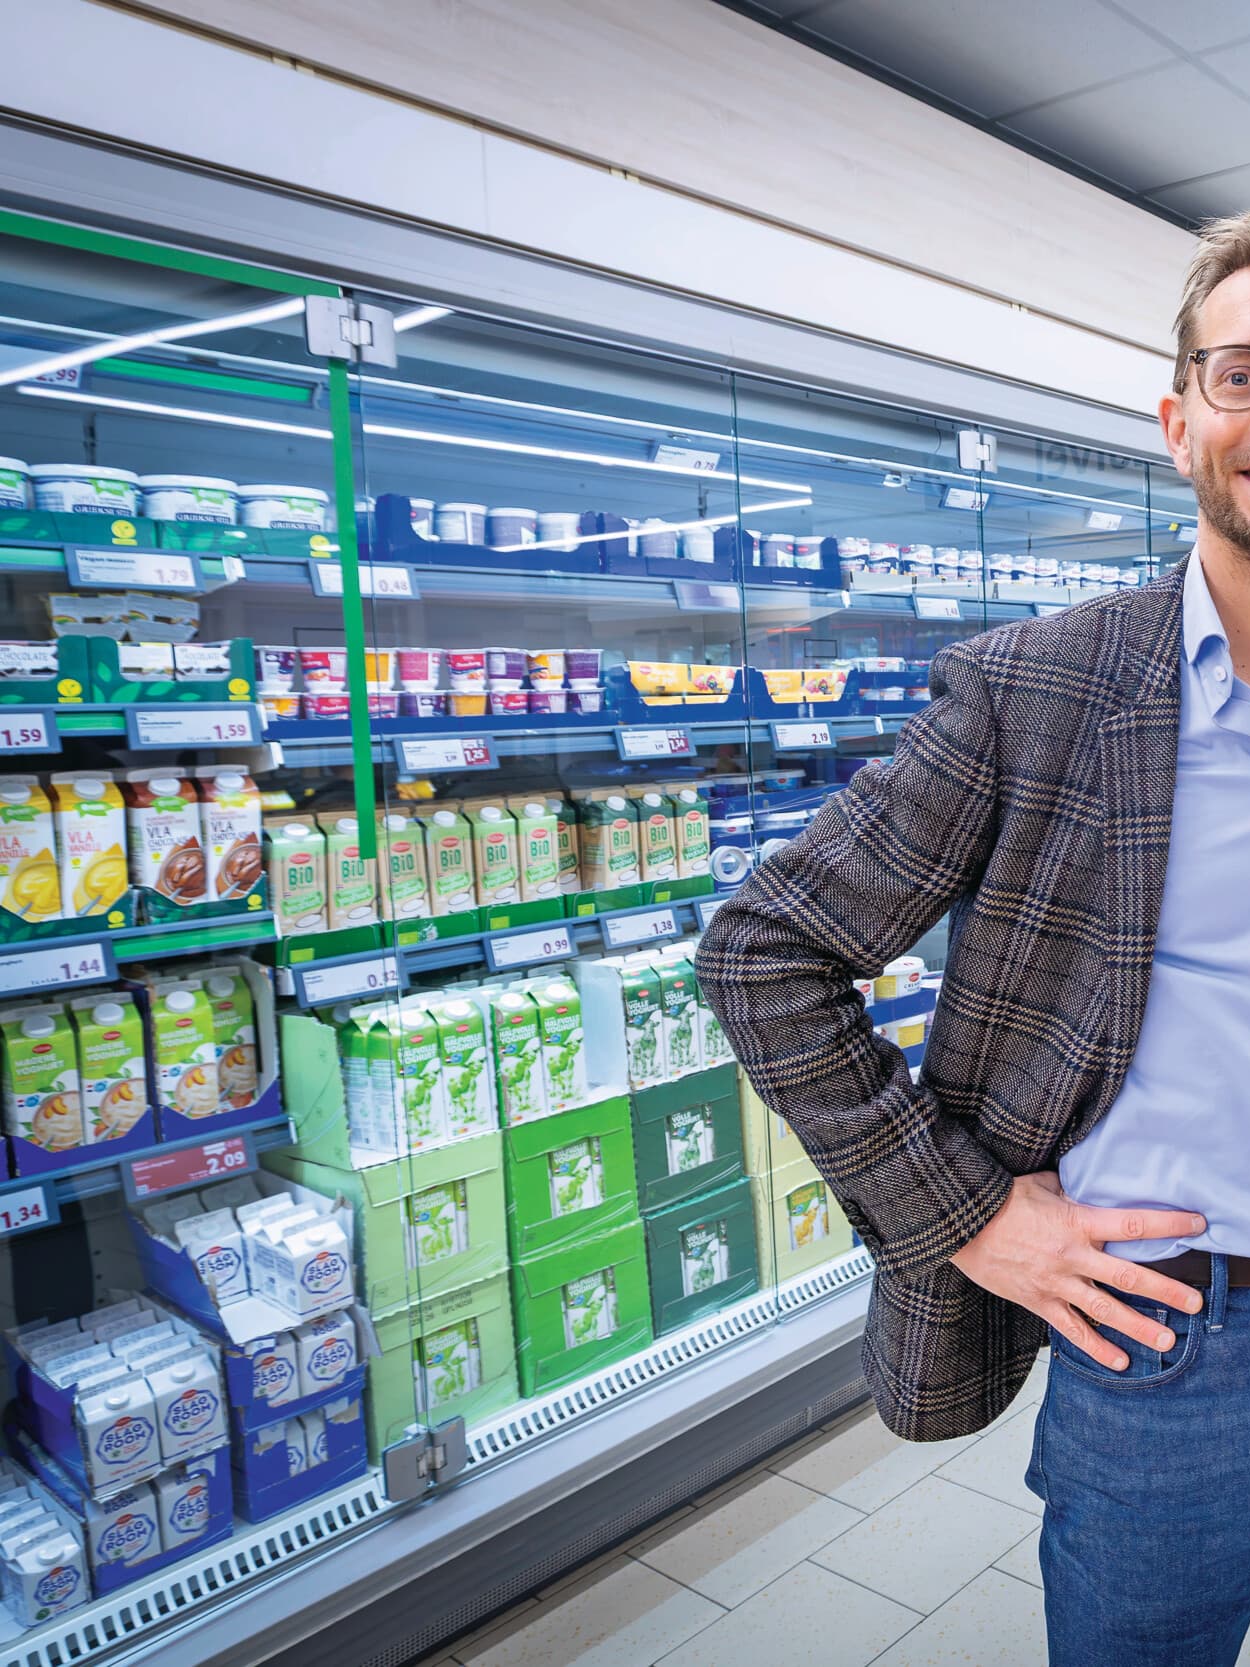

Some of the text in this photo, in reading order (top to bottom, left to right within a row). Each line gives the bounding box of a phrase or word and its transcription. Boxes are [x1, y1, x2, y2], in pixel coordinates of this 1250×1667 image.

[1, 728, 42, 746] 1.59
[213, 724, 247, 740] 1.59
[613, 831, 630, 846] BiO
[650, 826, 667, 842] BiO
[440, 849, 461, 867] BiO
[487, 844, 507, 862] BiO
[530, 840, 549, 857] BiO
[288, 866, 313, 886] BiO
[60, 959, 101, 980] 1.44
[206, 1151, 246, 1175] 2.09
[1, 1203, 42, 1228] 1.34
[172, 1404, 211, 1424] ROOM
[174, 1396, 207, 1415] SLAG
[104, 1431, 146, 1452] ROOM
[106, 1423, 142, 1441] SLAG
[107, 1520, 144, 1540] SLAG
[105, 1528, 147, 1552] ROOM
